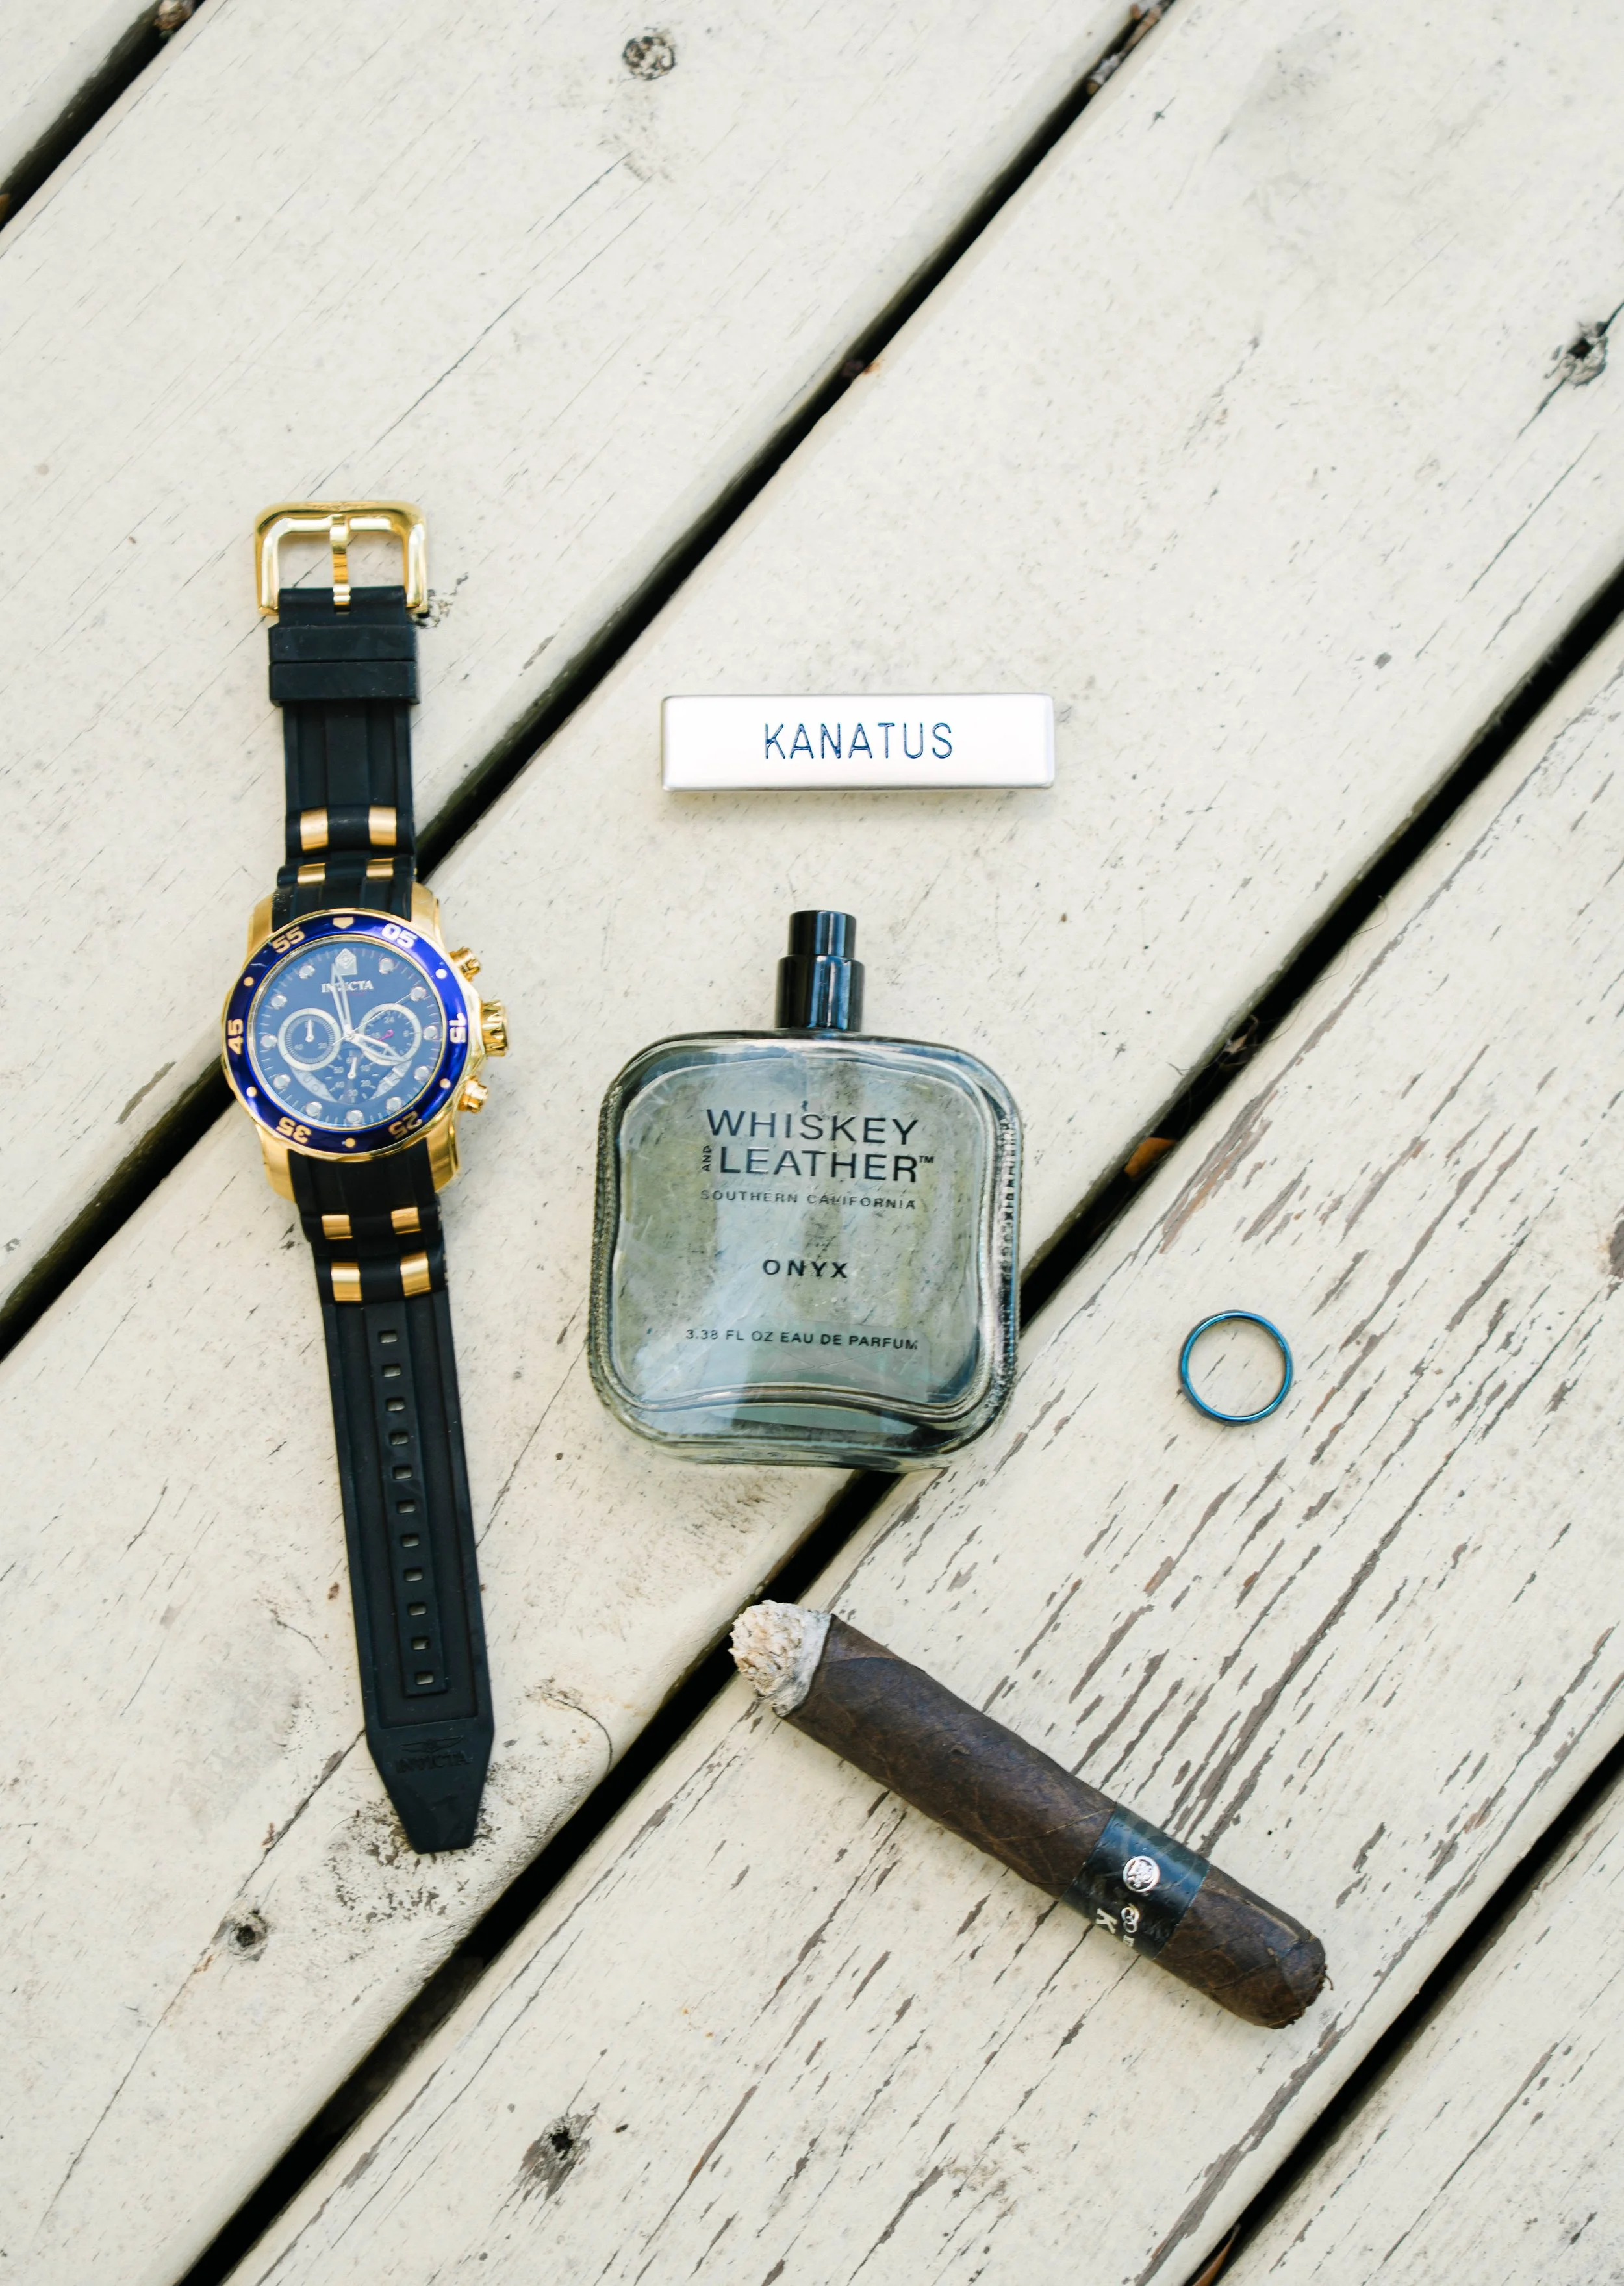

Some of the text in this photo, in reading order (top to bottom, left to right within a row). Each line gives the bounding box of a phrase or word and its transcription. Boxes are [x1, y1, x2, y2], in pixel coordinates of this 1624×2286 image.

[765, 722, 952, 759] KANATUS
[272, 926, 305, 953] 55
[381, 922, 418, 948] 05
[321, 980, 374, 993] ICTA
[227, 1018, 244, 1054] 45
[449, 1012, 466, 1043] 15
[275, 1117, 312, 1143] 35
[388, 1110, 422, 1139] 25
[707, 1108, 919, 1145] WHISKEY
[701, 1145, 712, 1172] AND
[700, 1189, 917, 1210] SOUTHERN CALIFORNIA
[762, 1258, 848, 1278] ONYX
[685, 1328, 918, 1351] 3.38 FL OZ EAU DE PARFUM
